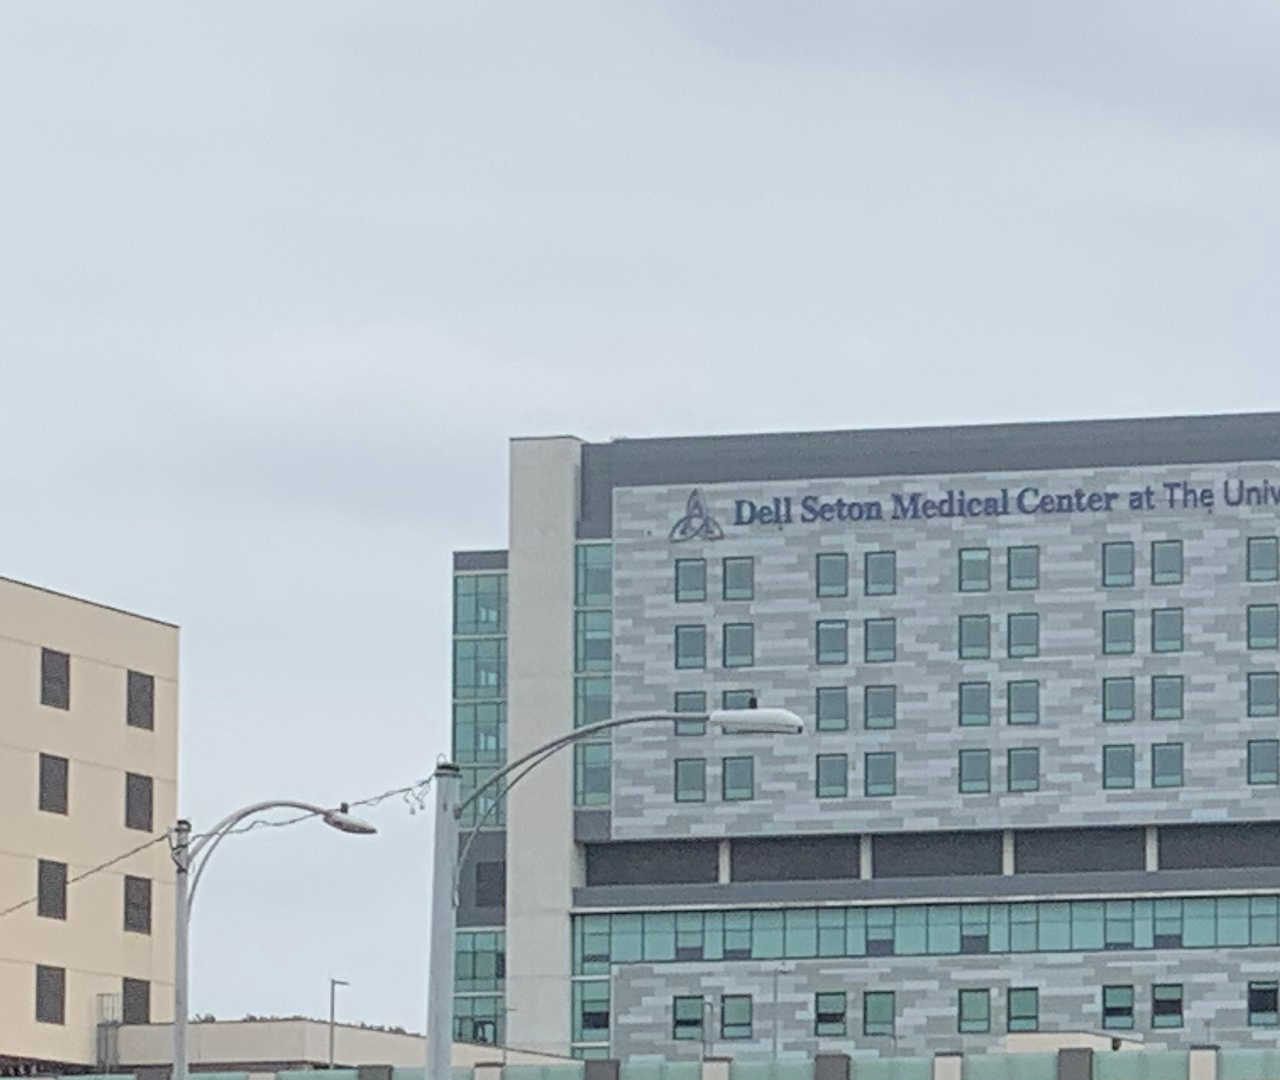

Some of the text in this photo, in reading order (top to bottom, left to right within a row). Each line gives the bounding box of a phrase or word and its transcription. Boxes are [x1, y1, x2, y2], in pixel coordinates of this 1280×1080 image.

[734, 497, 792, 526] Dell
[801, 495, 882, 522] Seton
[892, 488, 1009, 520] Medical
[1017, 486, 1118, 515] Center
[1129, 485, 1155, 510] at
[1164, 482, 1214, 508] The
